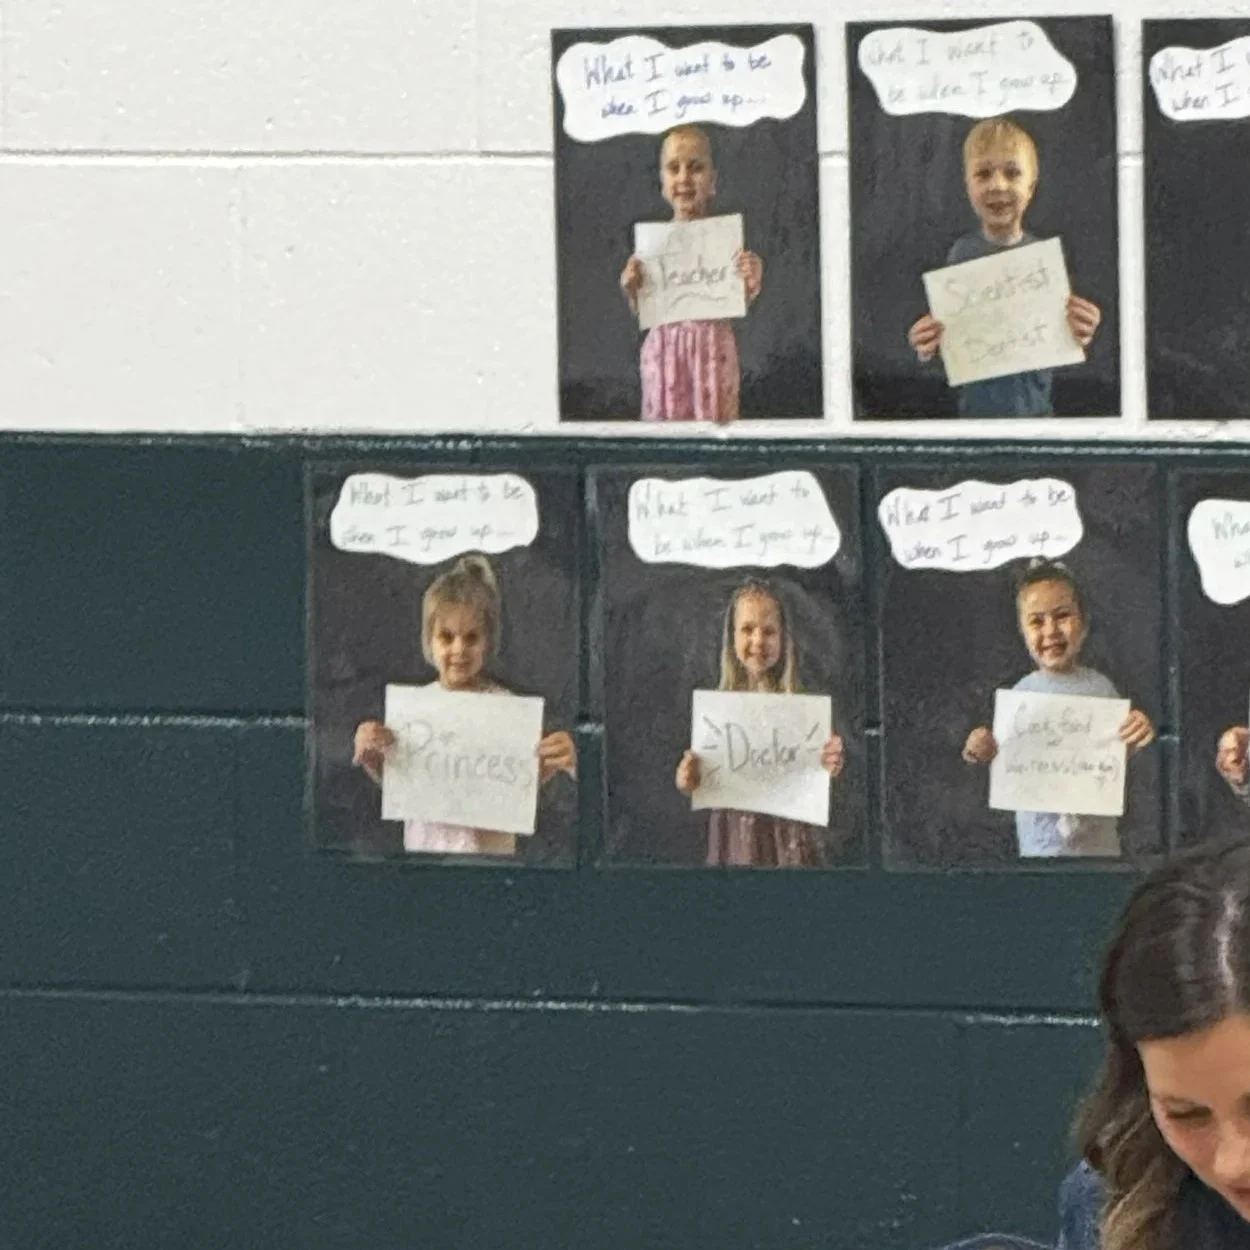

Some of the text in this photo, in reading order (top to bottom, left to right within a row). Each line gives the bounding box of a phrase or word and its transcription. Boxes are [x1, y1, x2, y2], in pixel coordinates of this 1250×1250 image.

[584, 53, 634, 90] What
[645, 53, 665, 82] I
[675, 55, 709, 77] want
[1156, 53, 1202, 83] What
[1210, 47, 1235, 74] I
[601, 97, 637, 118] when
[645, 90, 668, 115] I
[675, 94, 712, 118] grow
[1172, 92, 1209, 112] when
[1215, 83, 1238, 107] I
[635, 482, 688, 520] What
[704, 487, 733, 512] I
[740, 484, 778, 506] want
[887, 485, 1073, 526] What I want to be
[683, 527, 726, 550] when
[731, 523, 756, 548] I
[759, 529, 793, 556] grow
[905, 542, 940, 562] when
[947, 534, 968, 562] I
[983, 535, 1017, 564] grow
